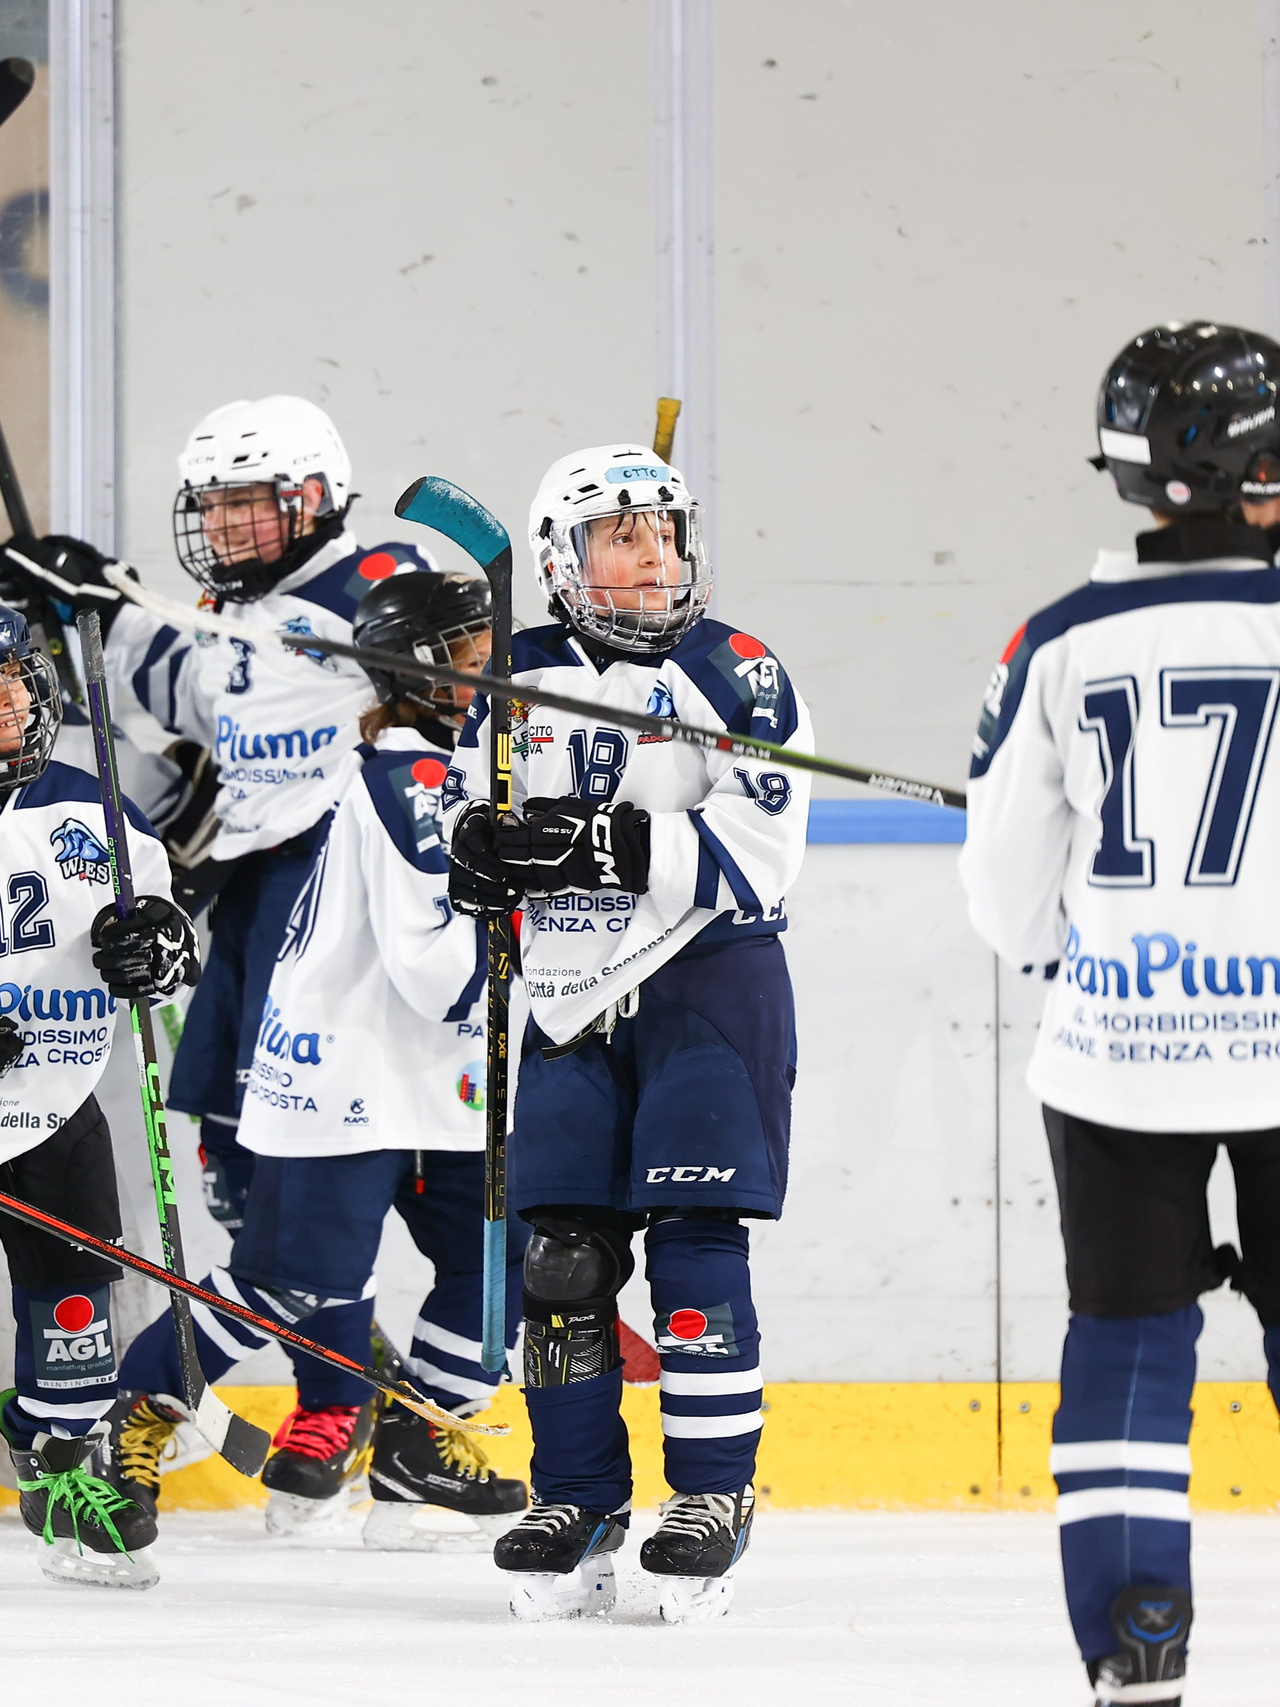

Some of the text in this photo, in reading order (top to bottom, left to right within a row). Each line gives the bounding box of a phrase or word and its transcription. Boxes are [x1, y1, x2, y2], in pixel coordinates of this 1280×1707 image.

[623, 467, 658, 479] OTTO
[1078, 666, 1280, 888] 17
[733, 767, 792, 817] 18
[527, 980, 556, 998] Città
[0, 1112, 41, 1129] della
[146, 1062, 178, 1206] CCM
[645, 1166, 737, 1184] CCM
[45, 1332, 112, 1362] AGL
